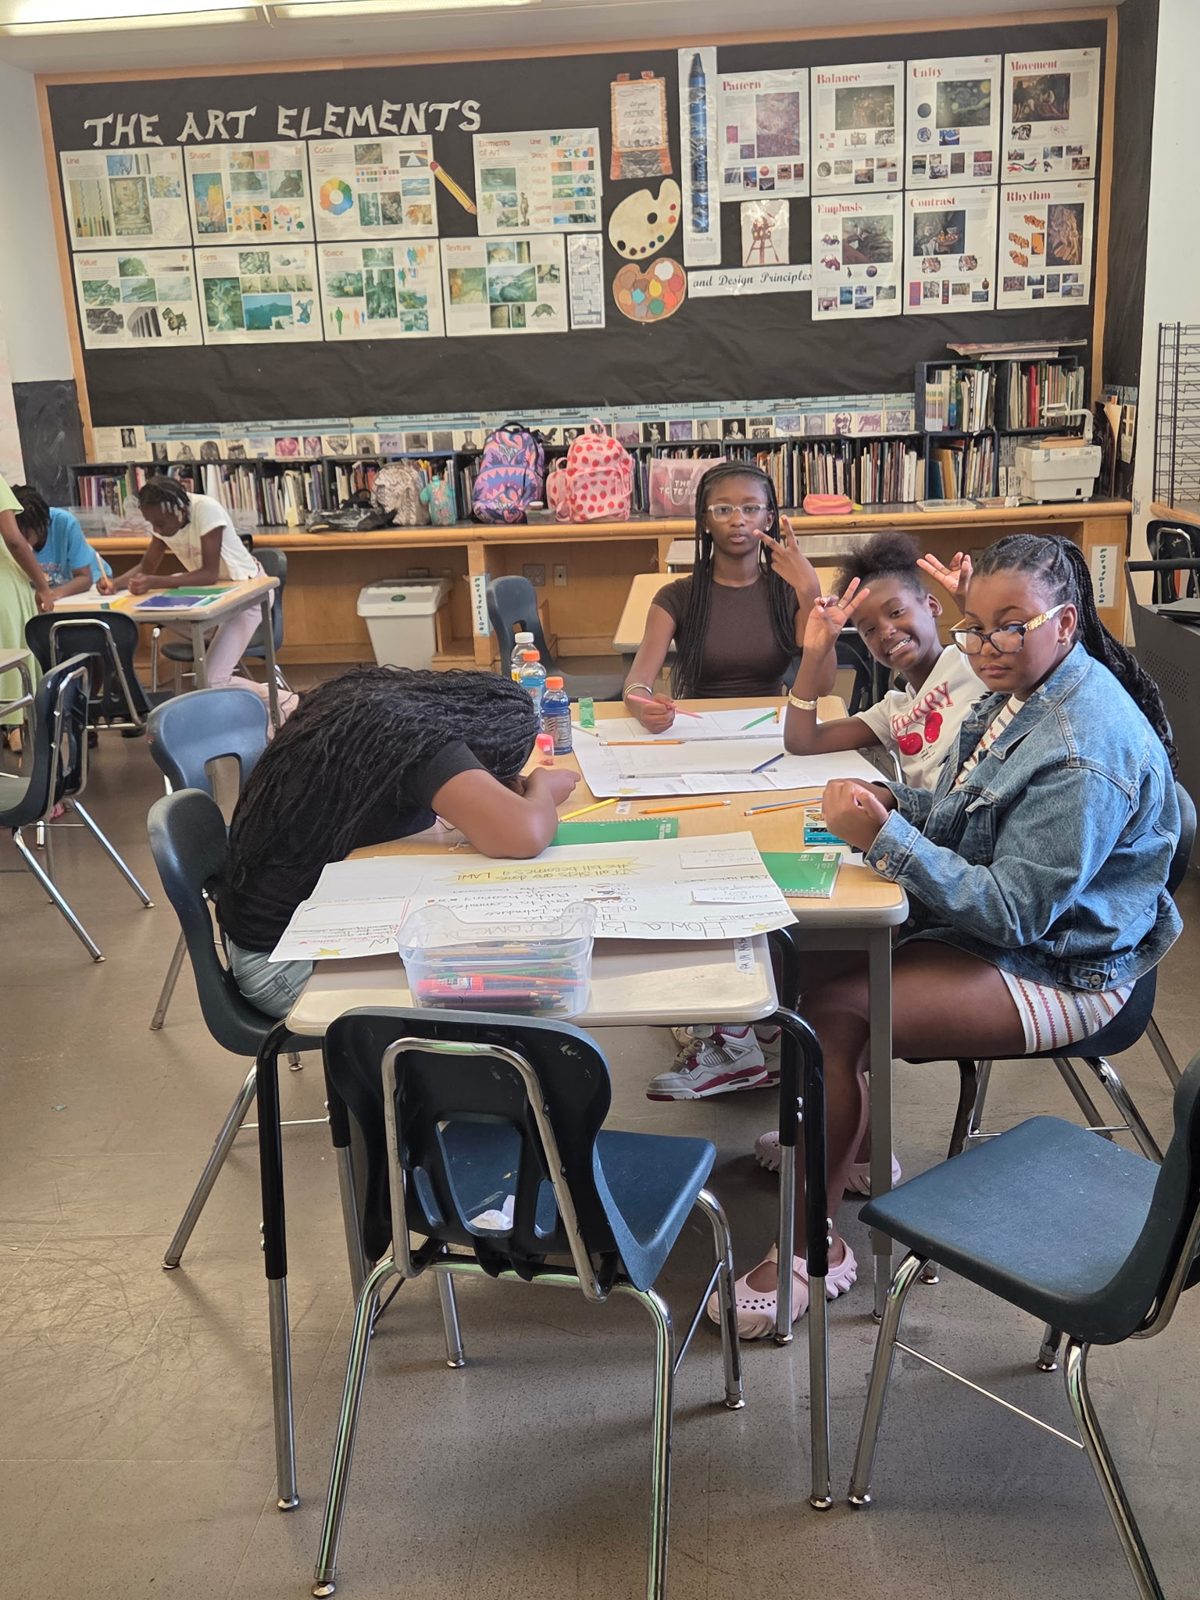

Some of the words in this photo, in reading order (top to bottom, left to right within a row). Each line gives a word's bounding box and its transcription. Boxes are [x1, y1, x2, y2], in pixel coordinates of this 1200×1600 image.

[912, 65, 944, 79] Unity
[1010, 59, 1058, 72] Movement
[816, 71, 861, 84] Balance
[722, 80, 762, 91] Pattern
[83, 112, 164, 147] THE
[176, 105, 259, 143] ART
[276, 98, 482, 139] ELEMENTS
[314, 145, 336, 155] Color
[910, 196, 957, 208] Contrast
[1006, 190, 1052, 204] Rhythm
[817, 202, 863, 215] Emphasis
[445, 243, 471, 253] Texture
[692, 276, 713, 288] and
[718, 271, 754, 287] Design
[760, 269, 812, 286] Principles
[671, 921, 726, 938] How
